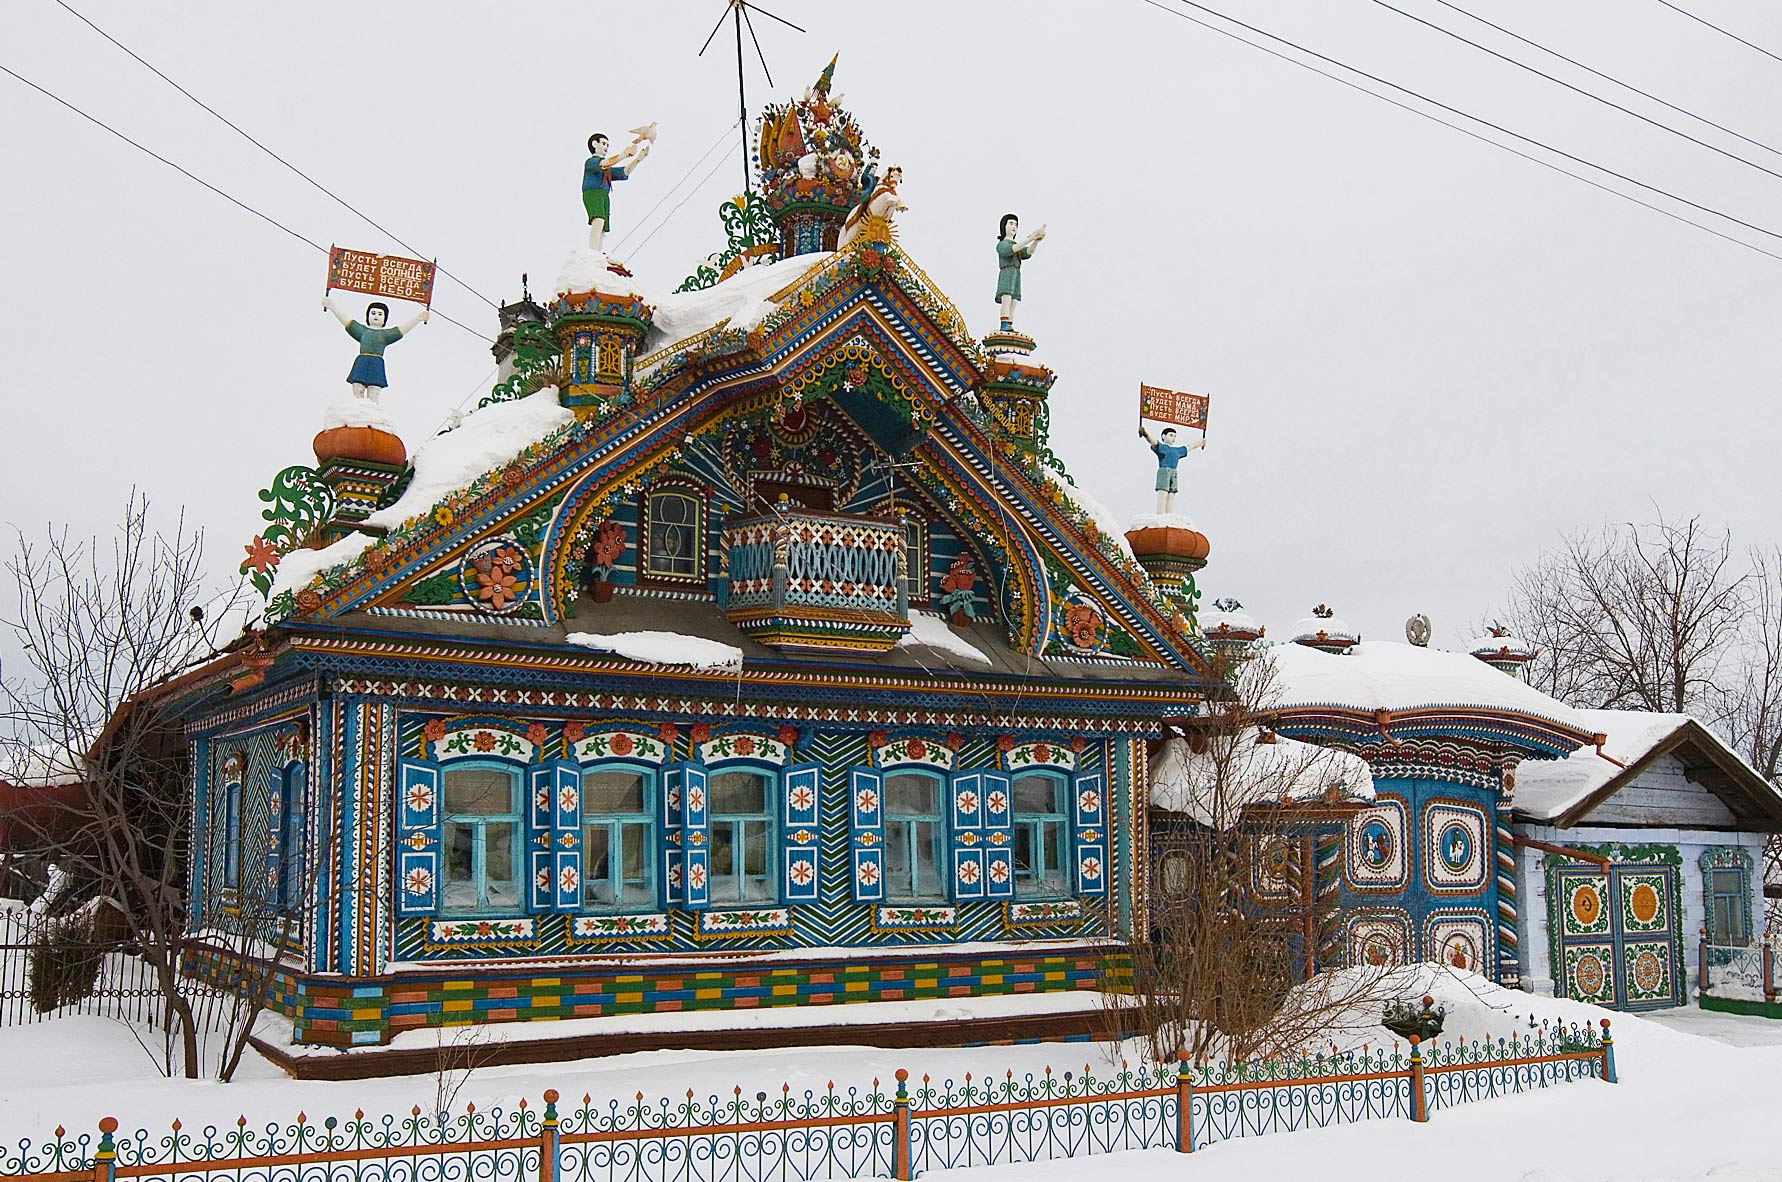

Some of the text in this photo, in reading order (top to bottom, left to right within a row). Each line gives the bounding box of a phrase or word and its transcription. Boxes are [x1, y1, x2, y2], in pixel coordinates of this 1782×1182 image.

[344, 252, 422, 272] ПУСТЬ ВСЕГДА
[341, 269, 420, 289] ПУСТЬ ВСЕГДА
[342, 262, 422, 281] БУДЕТ СОЛНЦЕ
[340, 278, 374, 290] БУДЕТ
[1150, 397, 1173, 406] БУДЕТ
[1151, 389, 1201, 405] ПУСТЬ ВСЕГДА
[1150, 402, 1200, 418] ПУСТЬ ВСЕГДА
[1150, 410, 1172, 418] БУДЕТ
